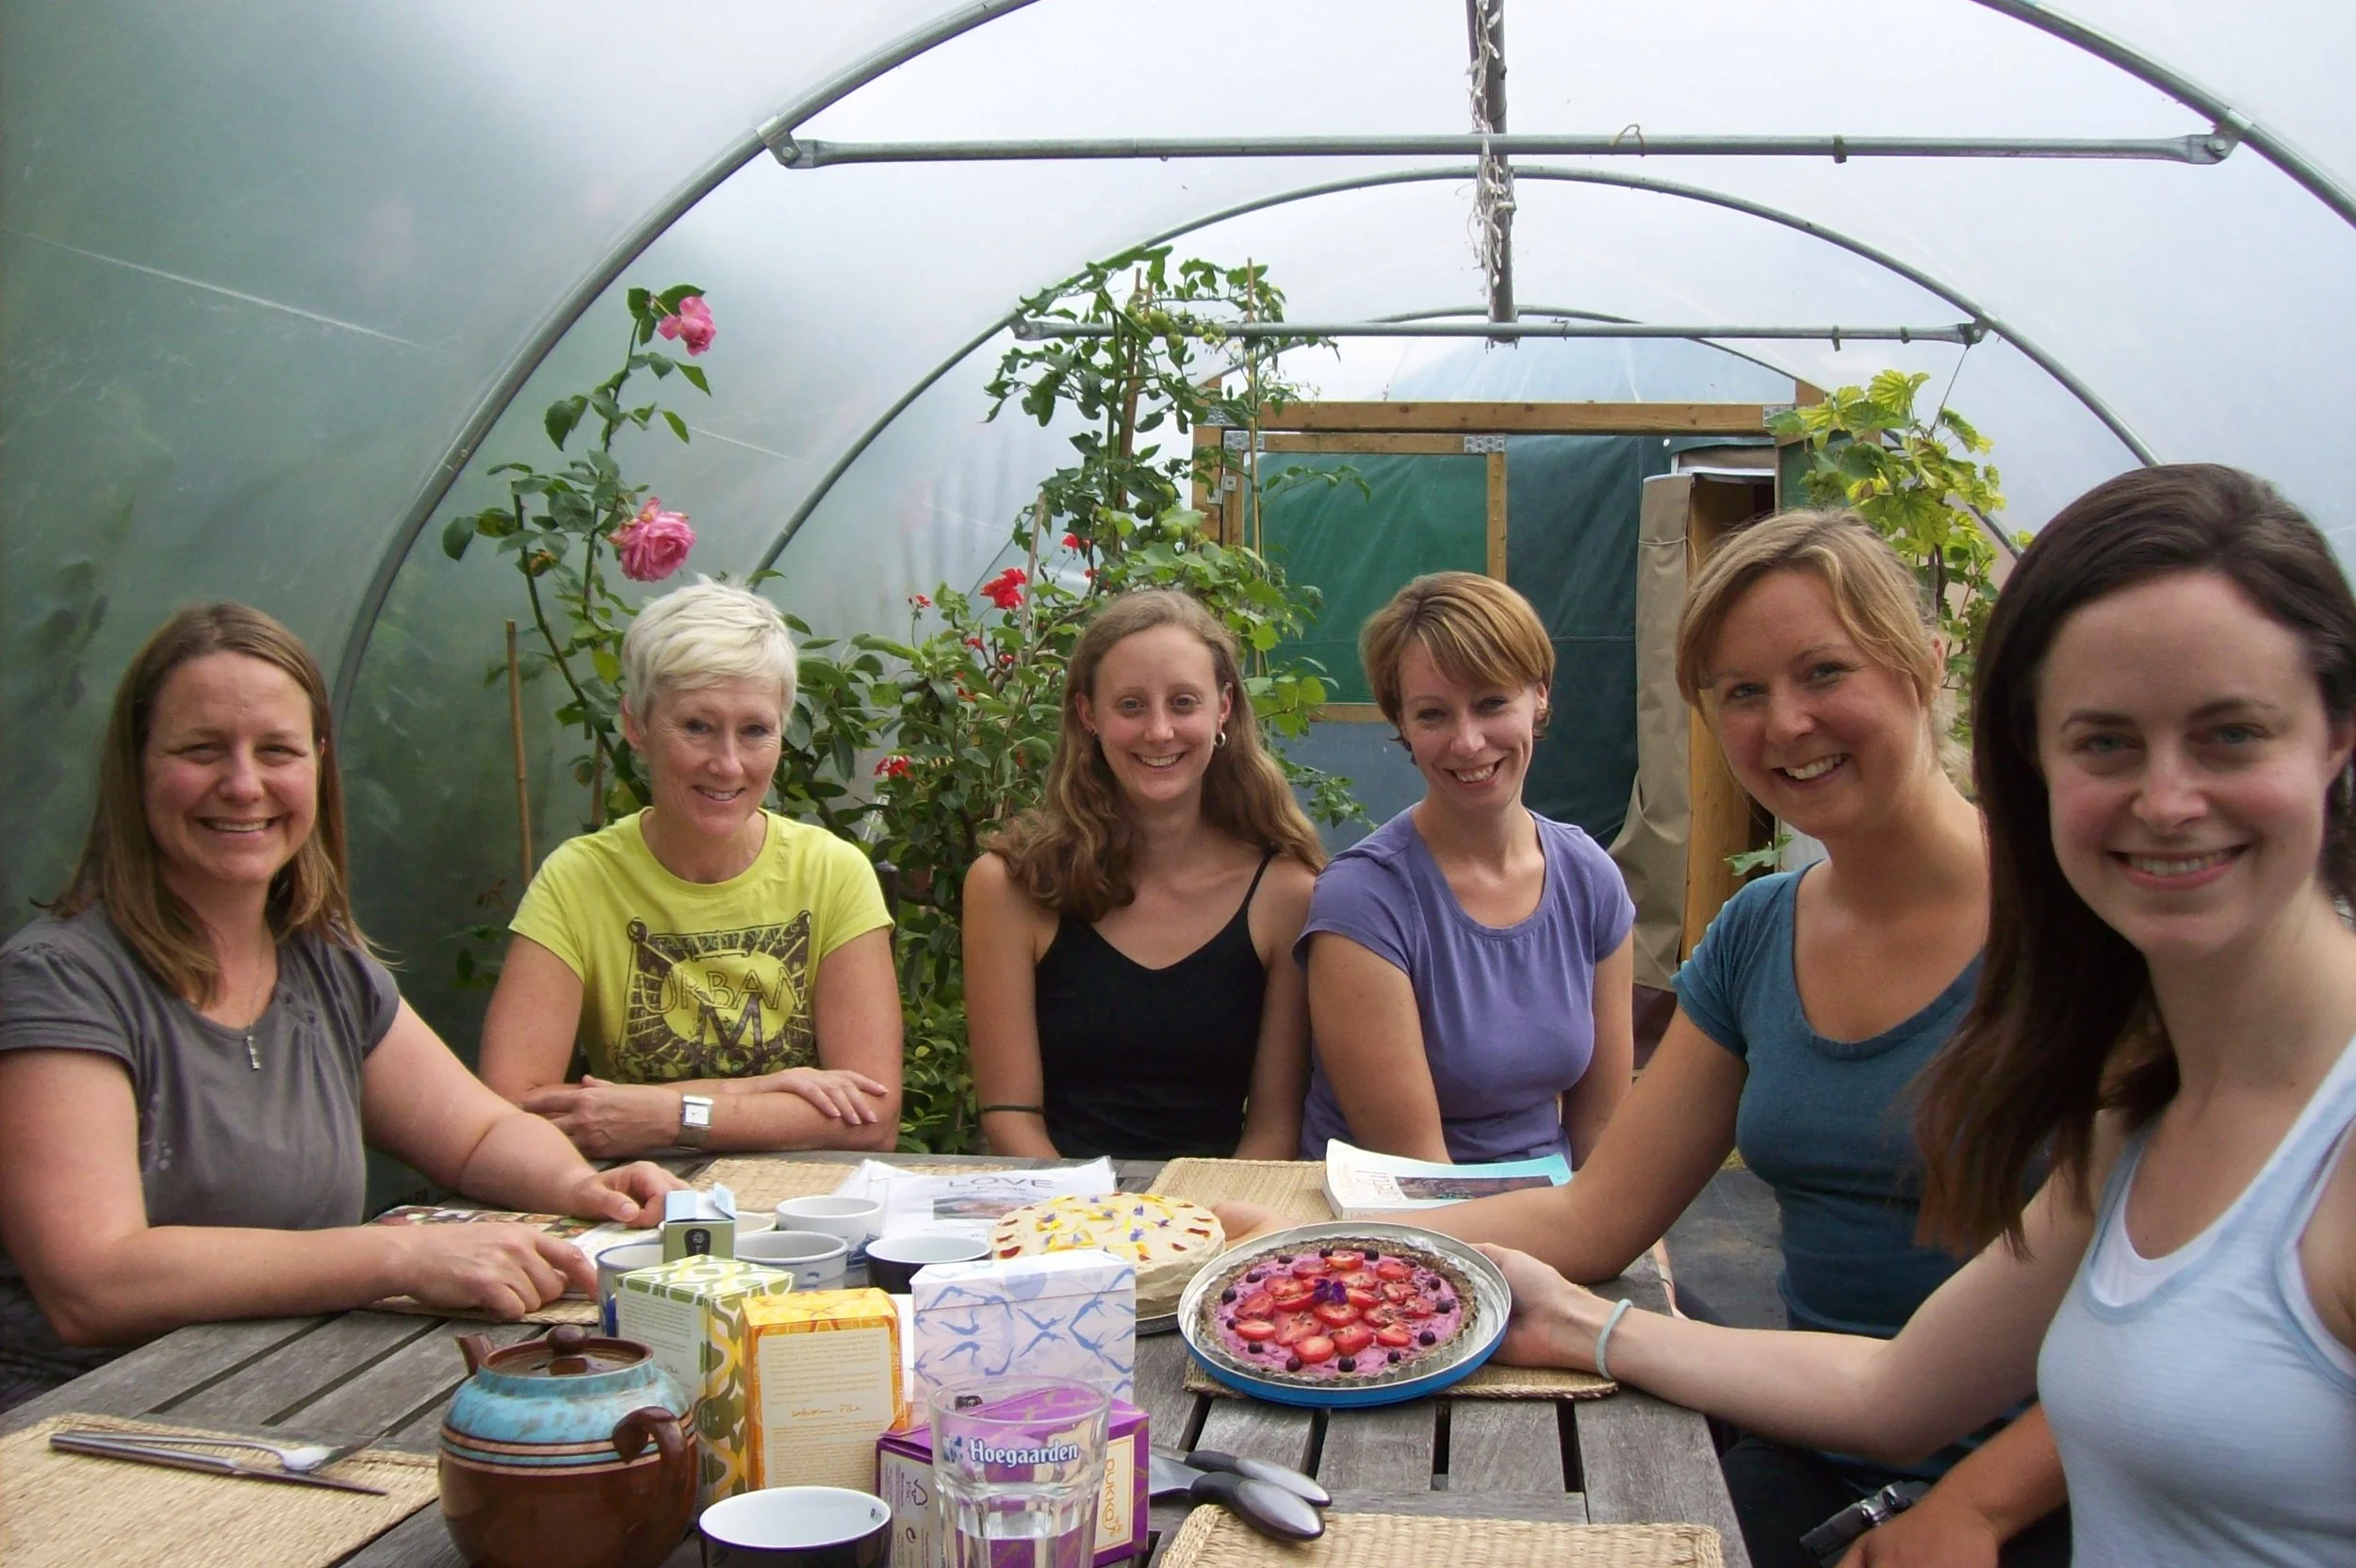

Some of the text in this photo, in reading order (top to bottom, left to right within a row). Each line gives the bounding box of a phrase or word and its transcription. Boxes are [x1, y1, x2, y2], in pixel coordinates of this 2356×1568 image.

[639, 966, 808, 1014] URBAN
[949, 1176, 1055, 1189] LOVE
[969, 1437, 1079, 1468] Hoegaarden
